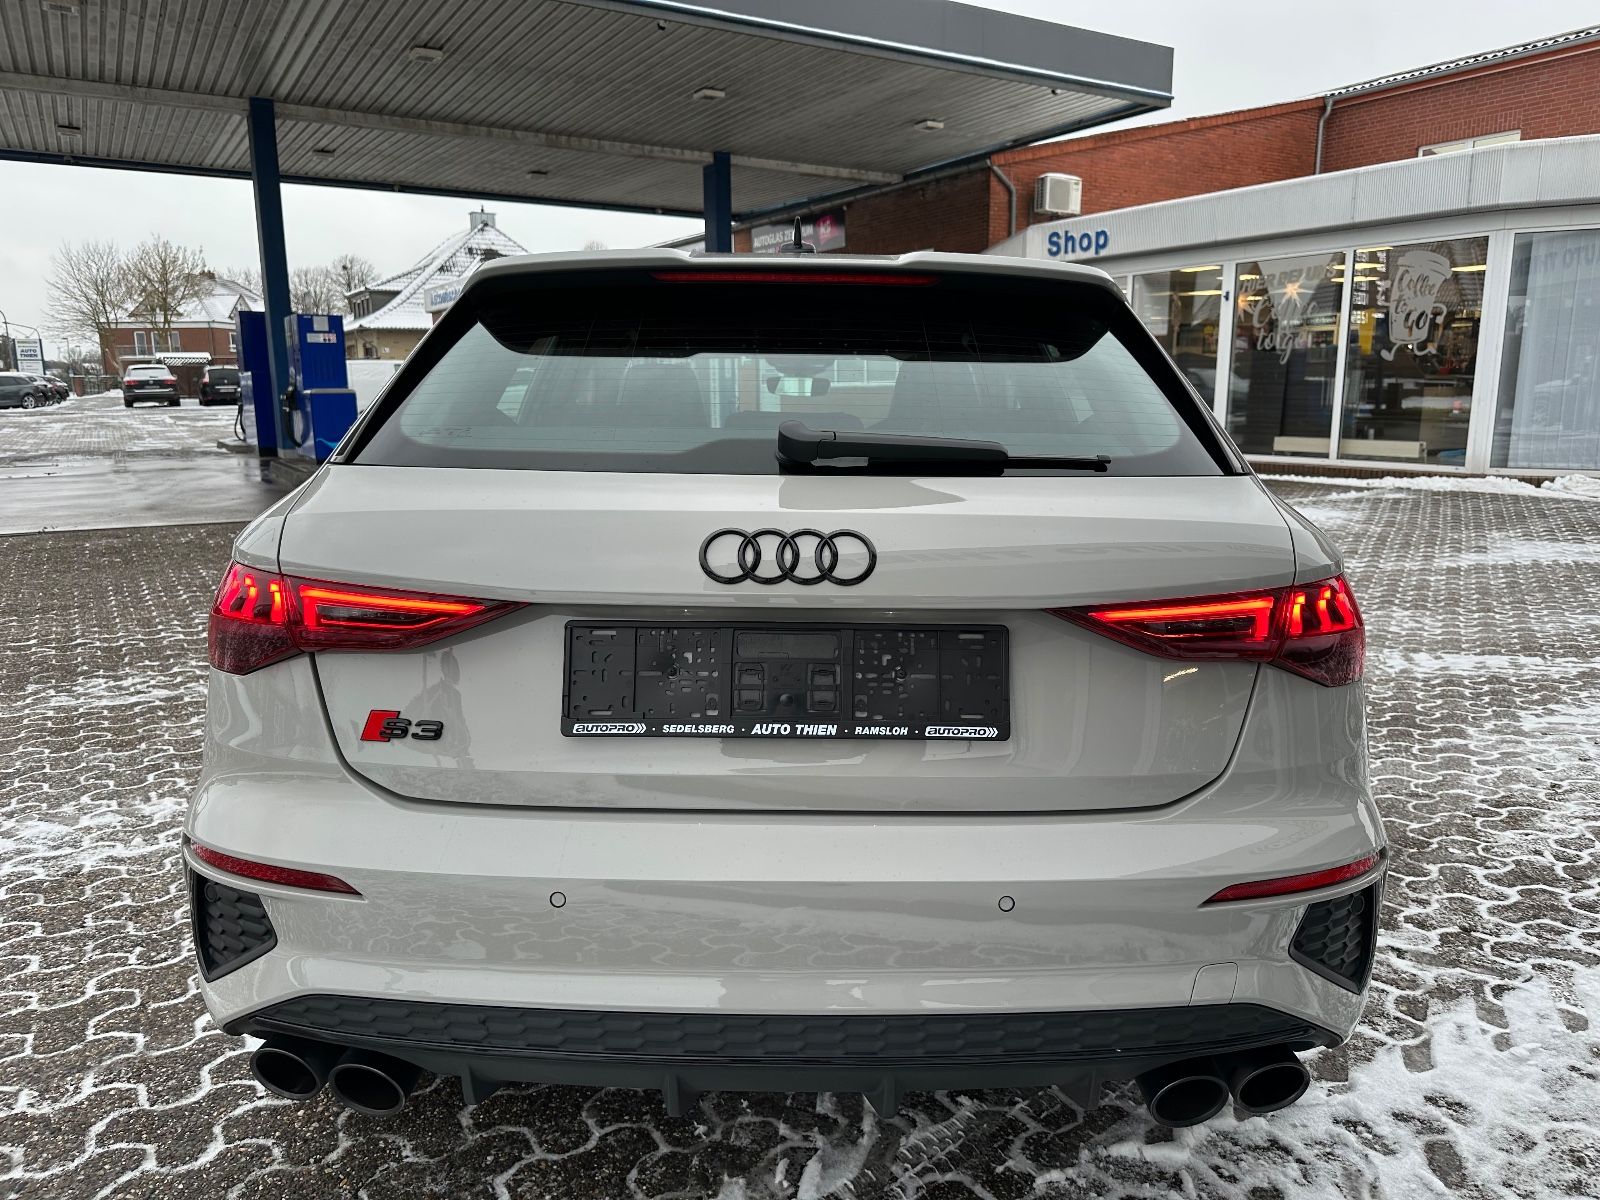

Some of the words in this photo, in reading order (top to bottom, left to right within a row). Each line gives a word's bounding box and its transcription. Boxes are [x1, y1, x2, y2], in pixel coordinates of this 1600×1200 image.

[753, 231, 784, 248] AUTOGLAS
[1047, 229, 1109, 257] Shop
[1397, 268, 1437, 298] Coffee
[379, 717, 445, 741] S3
[662, 724, 735, 735] SEDELSBERG
[751, 723, 791, 735] AUTO
[795, 723, 838, 736] THIEN
[854, 726, 909, 736] RAMSLOH
